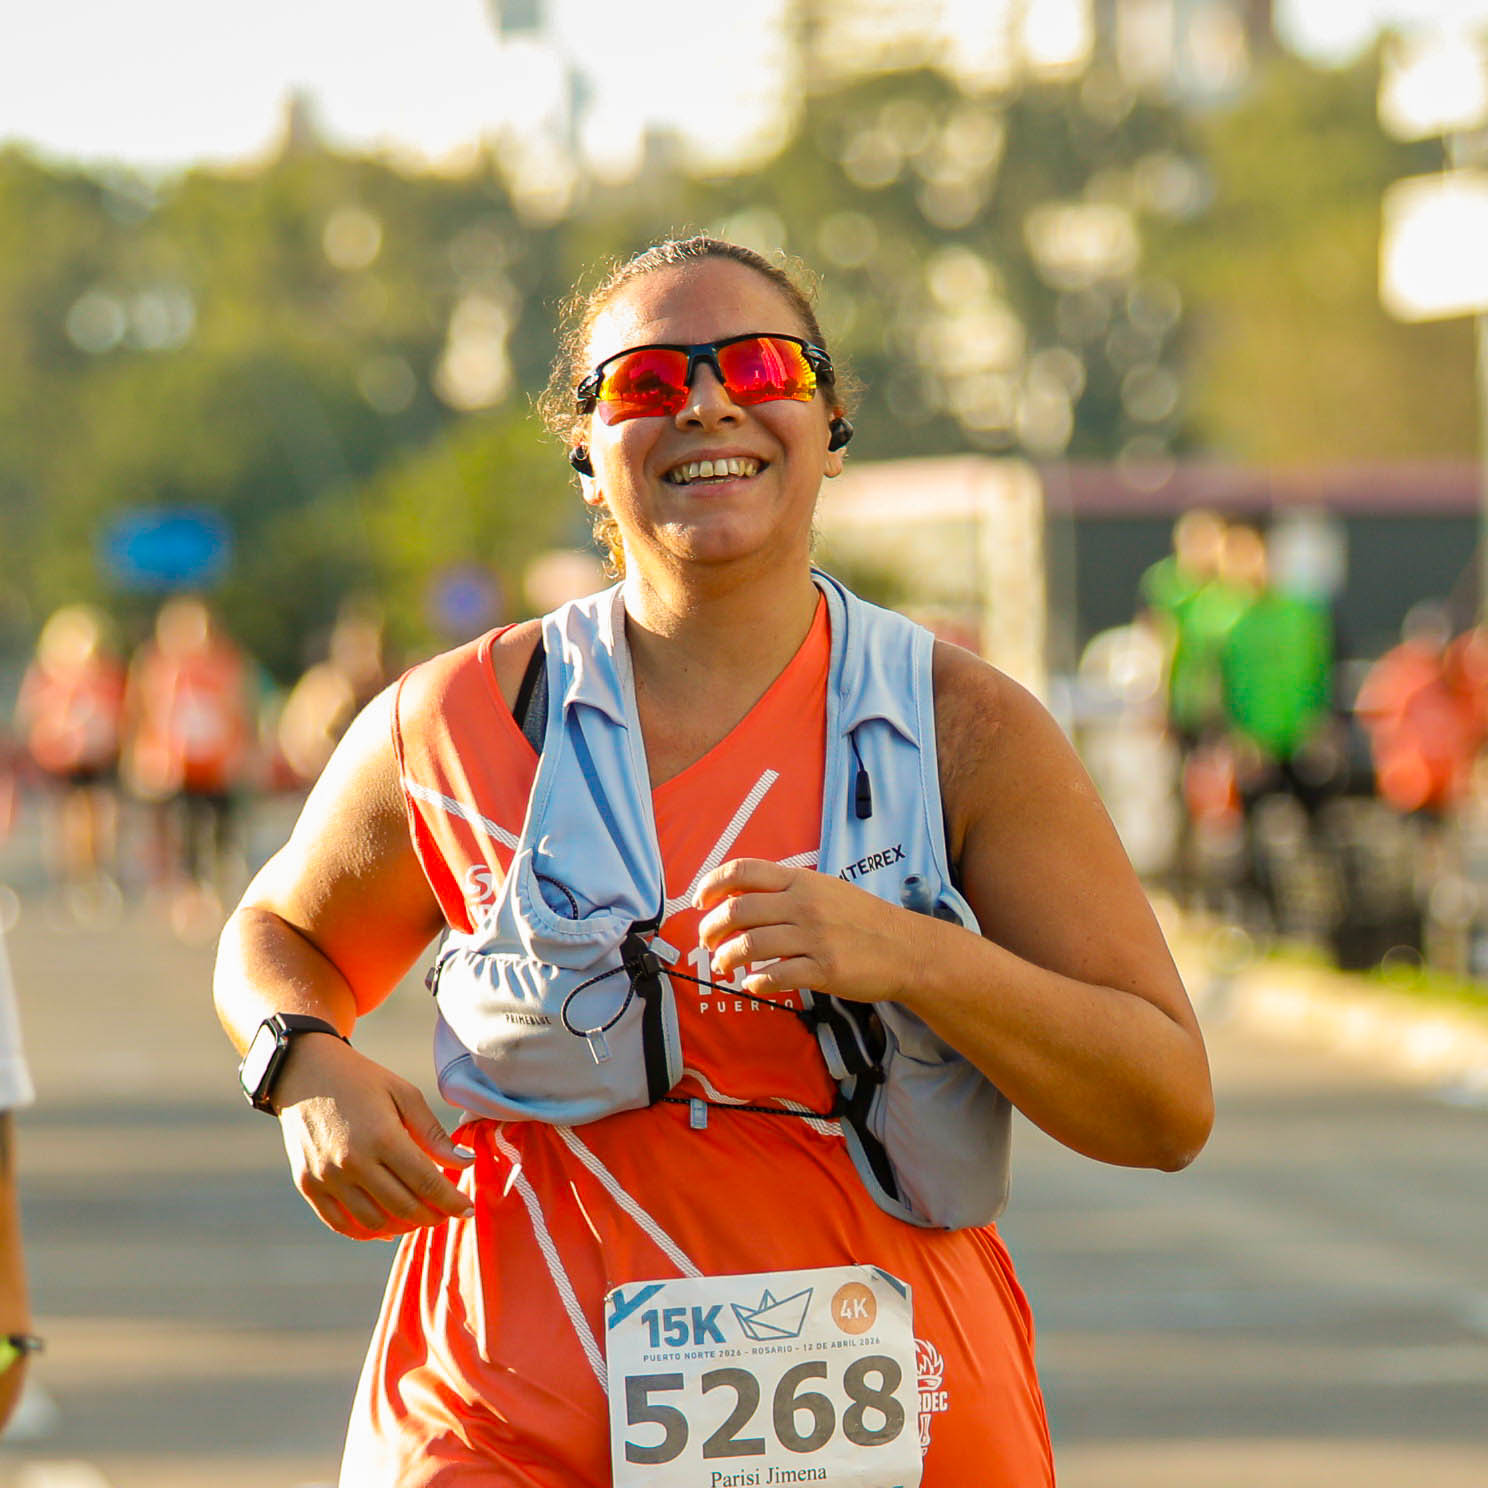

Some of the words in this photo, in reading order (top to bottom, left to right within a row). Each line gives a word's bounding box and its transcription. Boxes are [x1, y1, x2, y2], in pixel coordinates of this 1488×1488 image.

[846, 843, 906, 880] TERREX
[840, 1298, 869, 1320] 4K
[641, 1304, 727, 1348] 15K
[643, 1352, 681, 1362] PUERTO
[684, 1350, 716, 1360] NORTE
[719, 1349, 742, 1358] 2026
[751, 1345, 793, 1355] ROSARIO
[816, 1341, 828, 1351] DE
[831, 1339, 856, 1349] ABRIL
[860, 1337, 881, 1346] 2026
[624, 1355, 905, 1465] 5268
[711, 1468, 761, 1488] Parisi
[766, 1466, 828, 1486] Jimena
